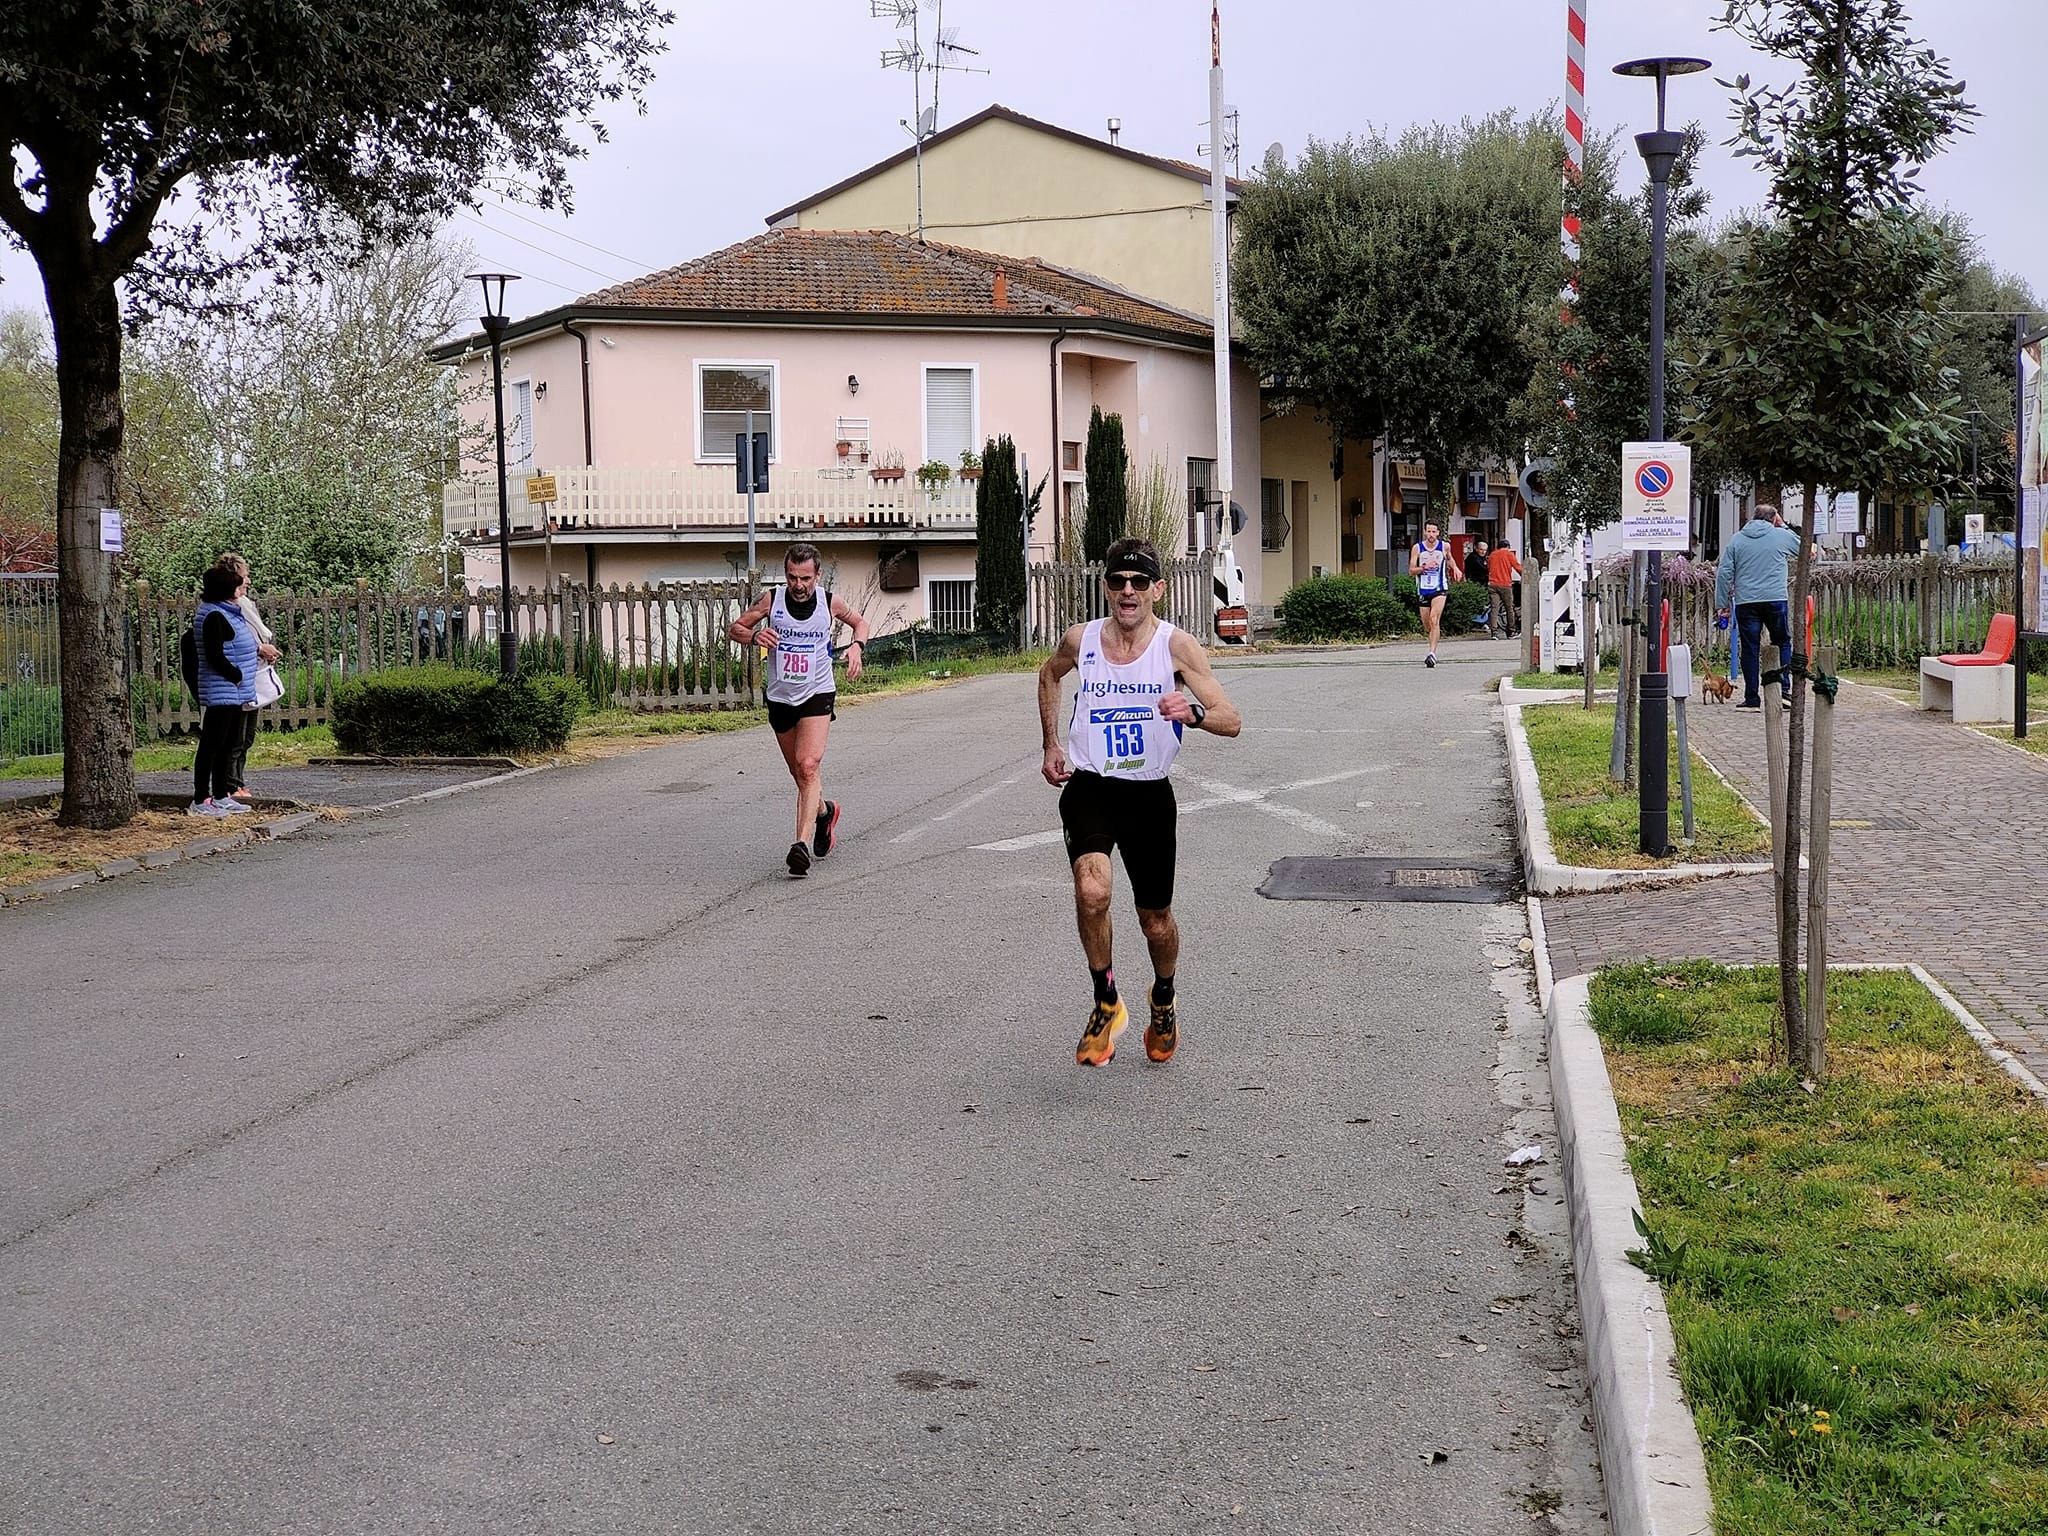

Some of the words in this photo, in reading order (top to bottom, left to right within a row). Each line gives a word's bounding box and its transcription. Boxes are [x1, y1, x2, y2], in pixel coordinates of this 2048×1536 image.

[774, 626, 823, 638] lughesina
[784, 653, 808, 673] 285
[1082, 679, 1162, 697] lughesina
[1112, 711, 1152, 721] Mizuno
[1103, 723, 1144, 758] 153
